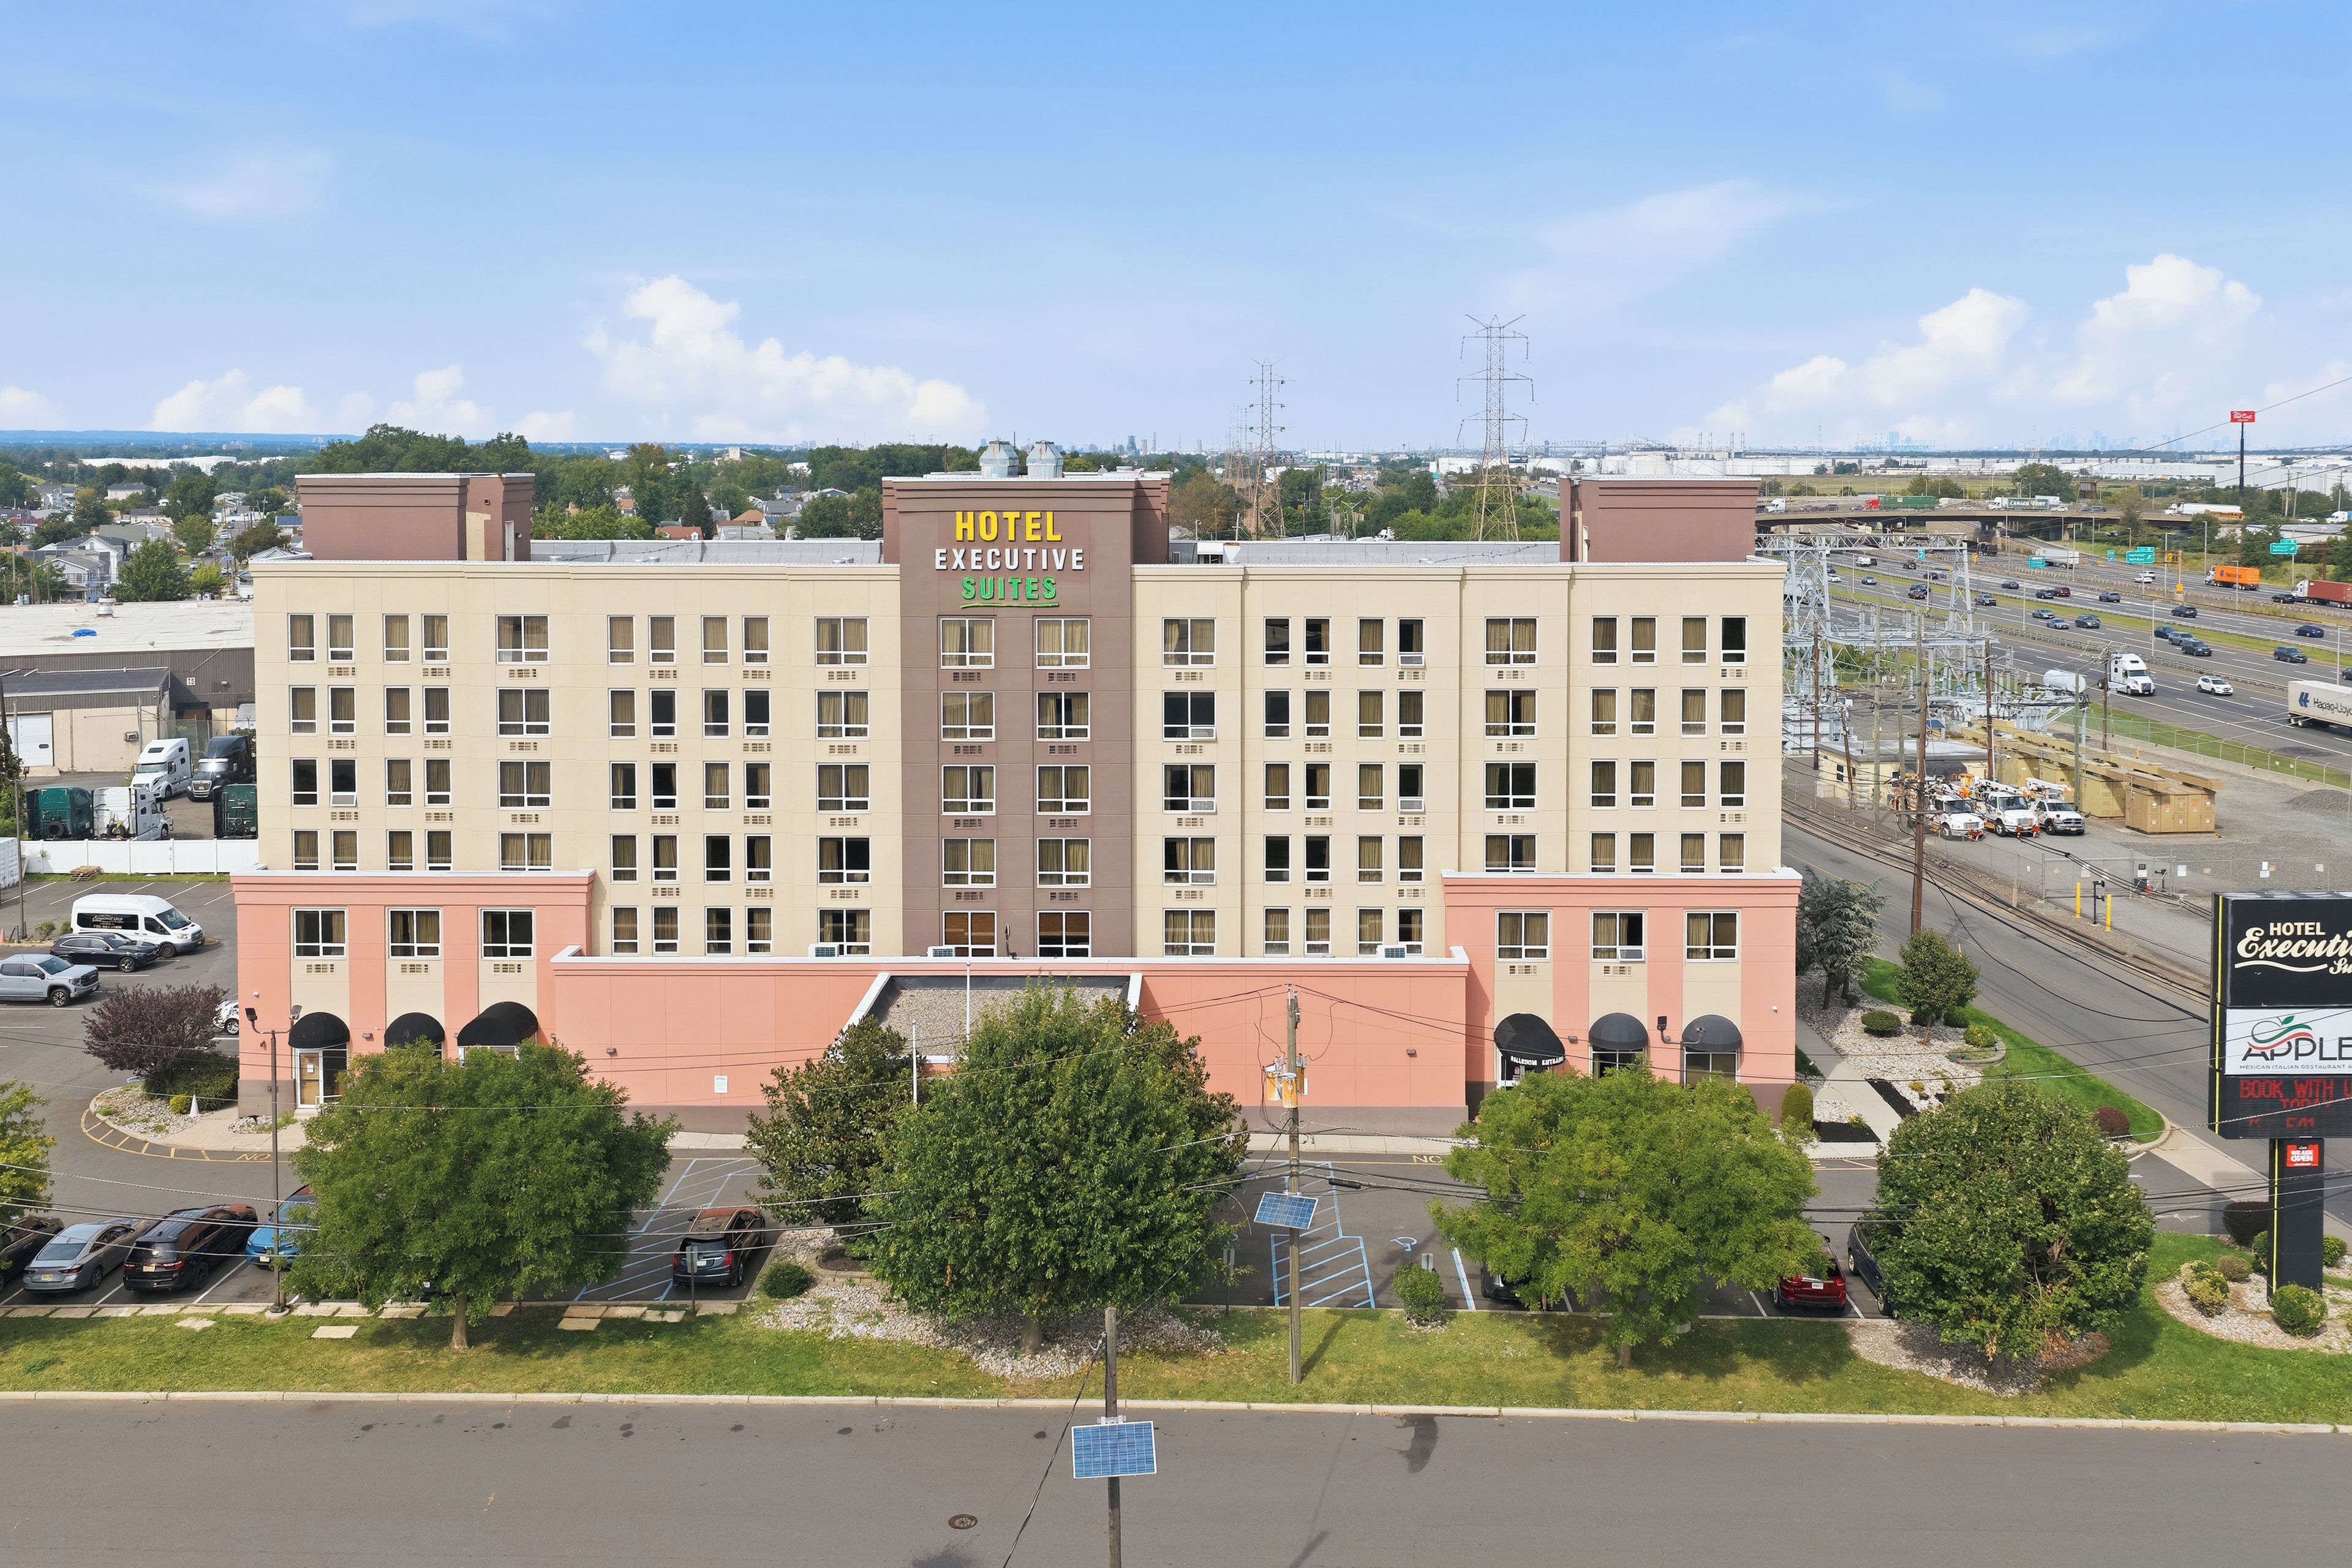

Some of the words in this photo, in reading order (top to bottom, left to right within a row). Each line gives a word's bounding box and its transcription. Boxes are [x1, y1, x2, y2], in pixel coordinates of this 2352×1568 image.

[956, 511, 1062, 541] HOTEL
[935, 548, 1084, 570] EXECUTIVE
[961, 576, 1057, 600] SUITES
[2269, 922, 2326, 936] HOTEL
[2237, 927, 2352, 960] Executi
[2241, 1036, 2352, 1061] APPLE
[2239, 1079, 2284, 1098] BOOK
[2293, 1079, 2334, 1099] WITH
[236, 1153, 271, 1161] NO
[1412, 1155, 1443, 1163] NO
